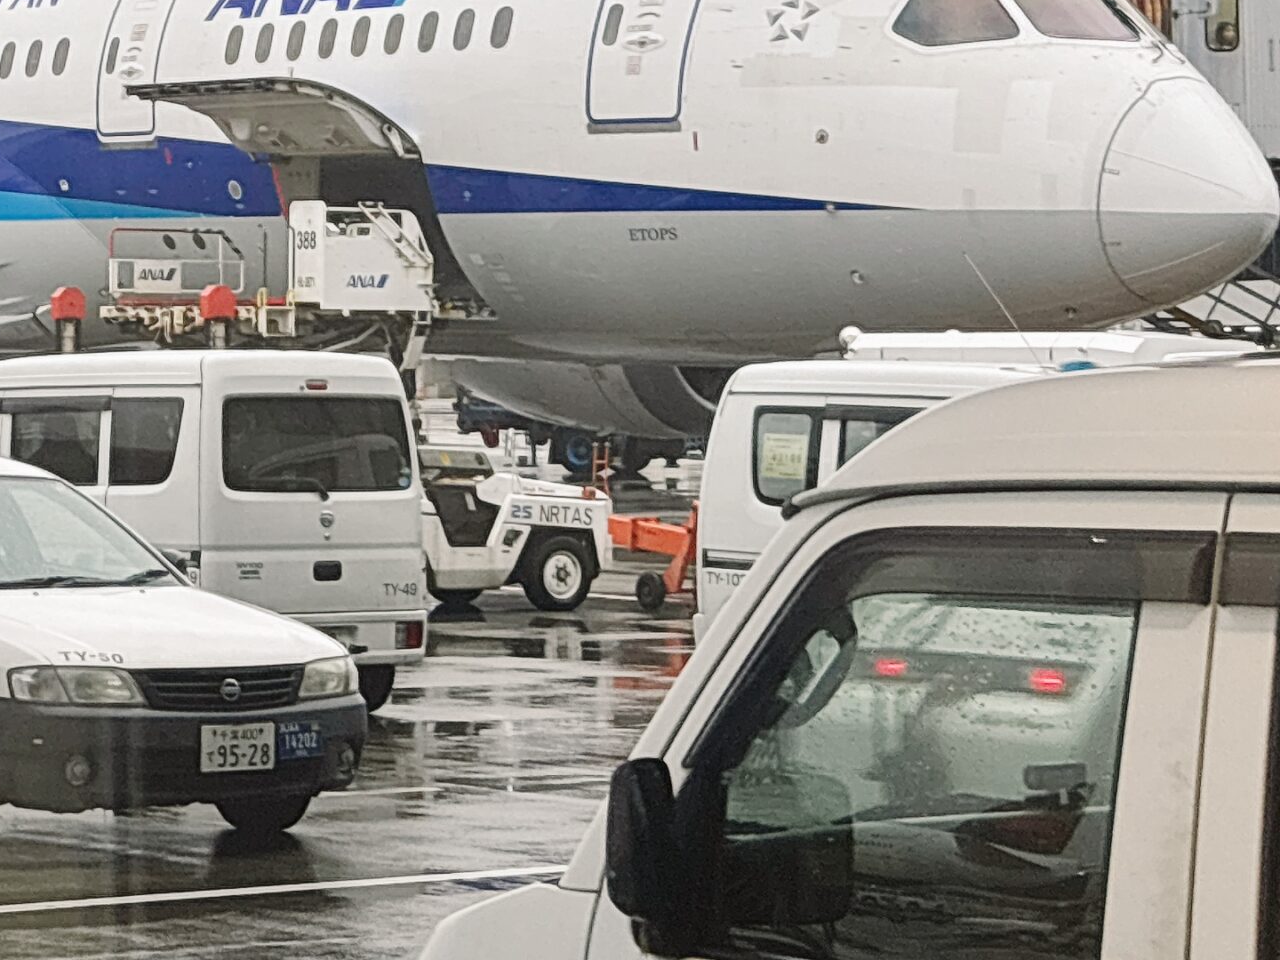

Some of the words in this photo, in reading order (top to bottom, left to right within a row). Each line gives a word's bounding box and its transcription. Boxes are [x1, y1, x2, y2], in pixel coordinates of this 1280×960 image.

[297, 230, 317, 250] 388
[627, 227, 678, 241] ETOPS
[138, 268, 164, 281] ANA
[346, 275, 375, 288] ANA
[539, 505, 592, 526] NRTAS
[706, 571, 746, 587] TY-10
[382, 583, 417, 596] TY-49
[58, 651, 124, 664] TY-50
[284, 732, 318, 750] 14202
[217, 743, 270, 768] 95-28
